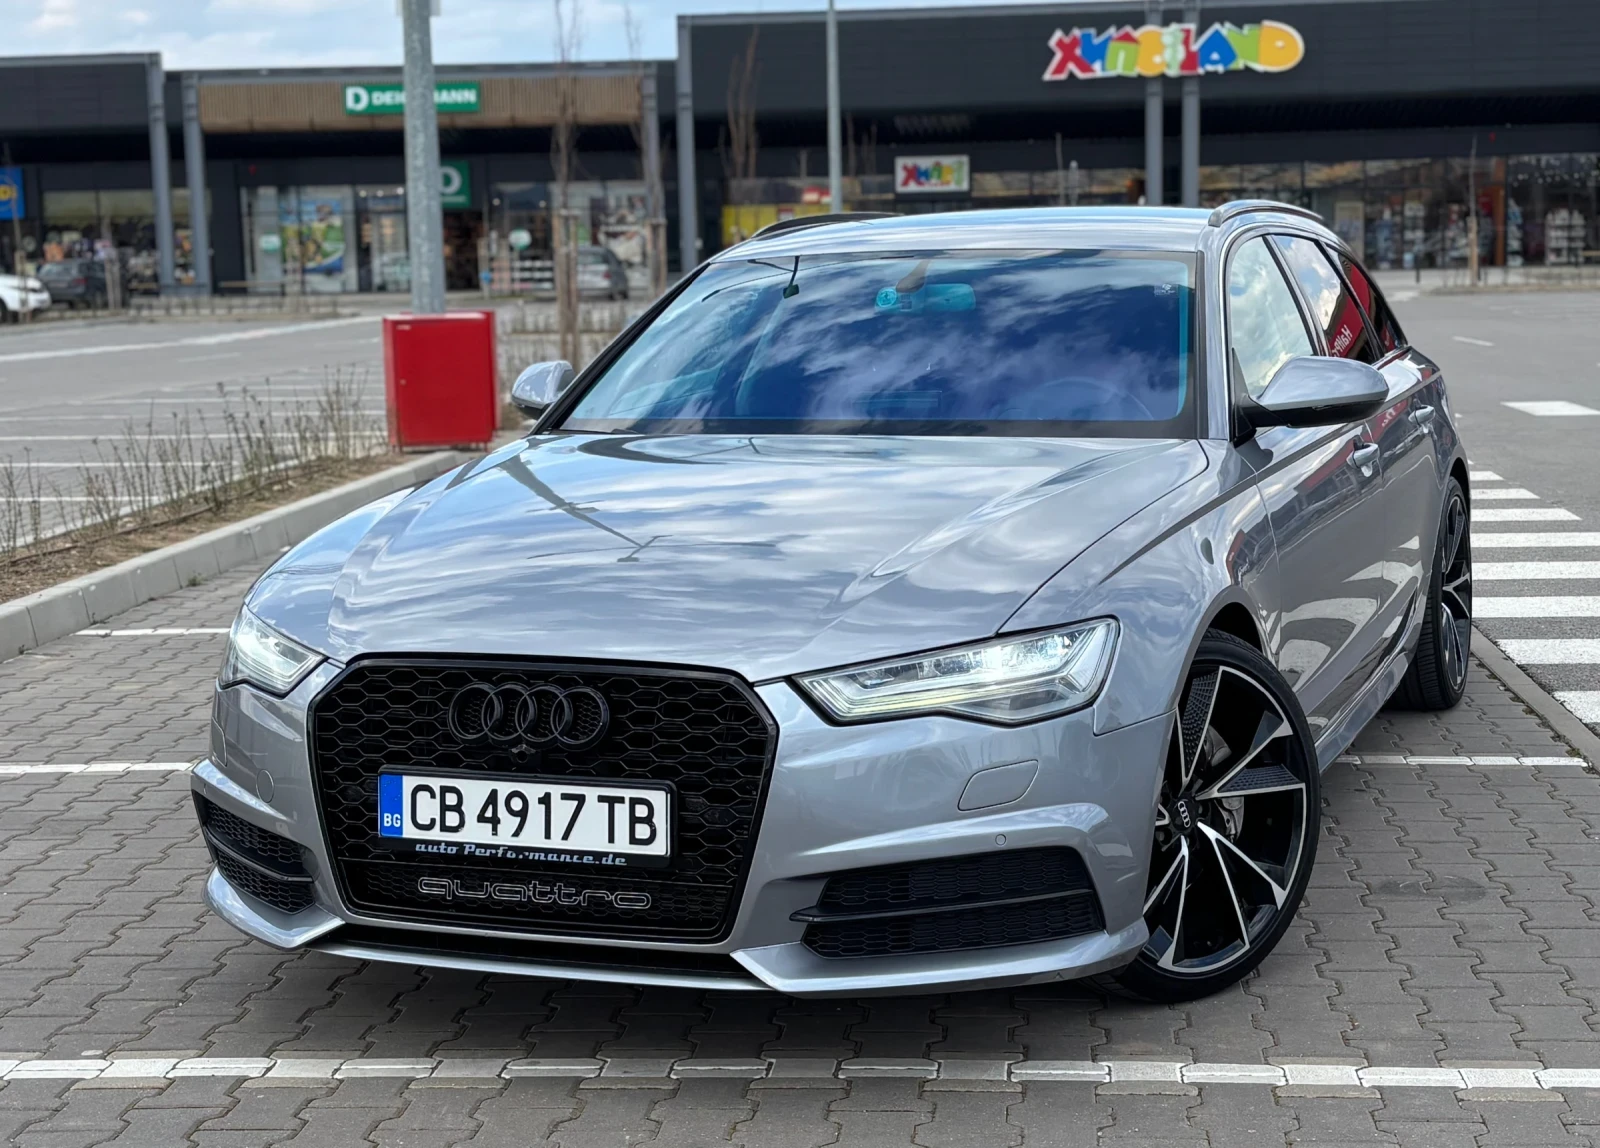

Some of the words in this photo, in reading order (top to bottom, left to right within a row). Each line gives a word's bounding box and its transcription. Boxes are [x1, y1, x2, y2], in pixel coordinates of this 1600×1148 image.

[371, 88, 477, 106] DEIANN
[383, 812, 401, 828] BG
[410, 783, 466, 833] CB
[476, 788, 586, 841] 4917
[597, 794, 657, 846] TB
[415, 842, 459, 855] auto
[418, 876, 652, 909] quattro
